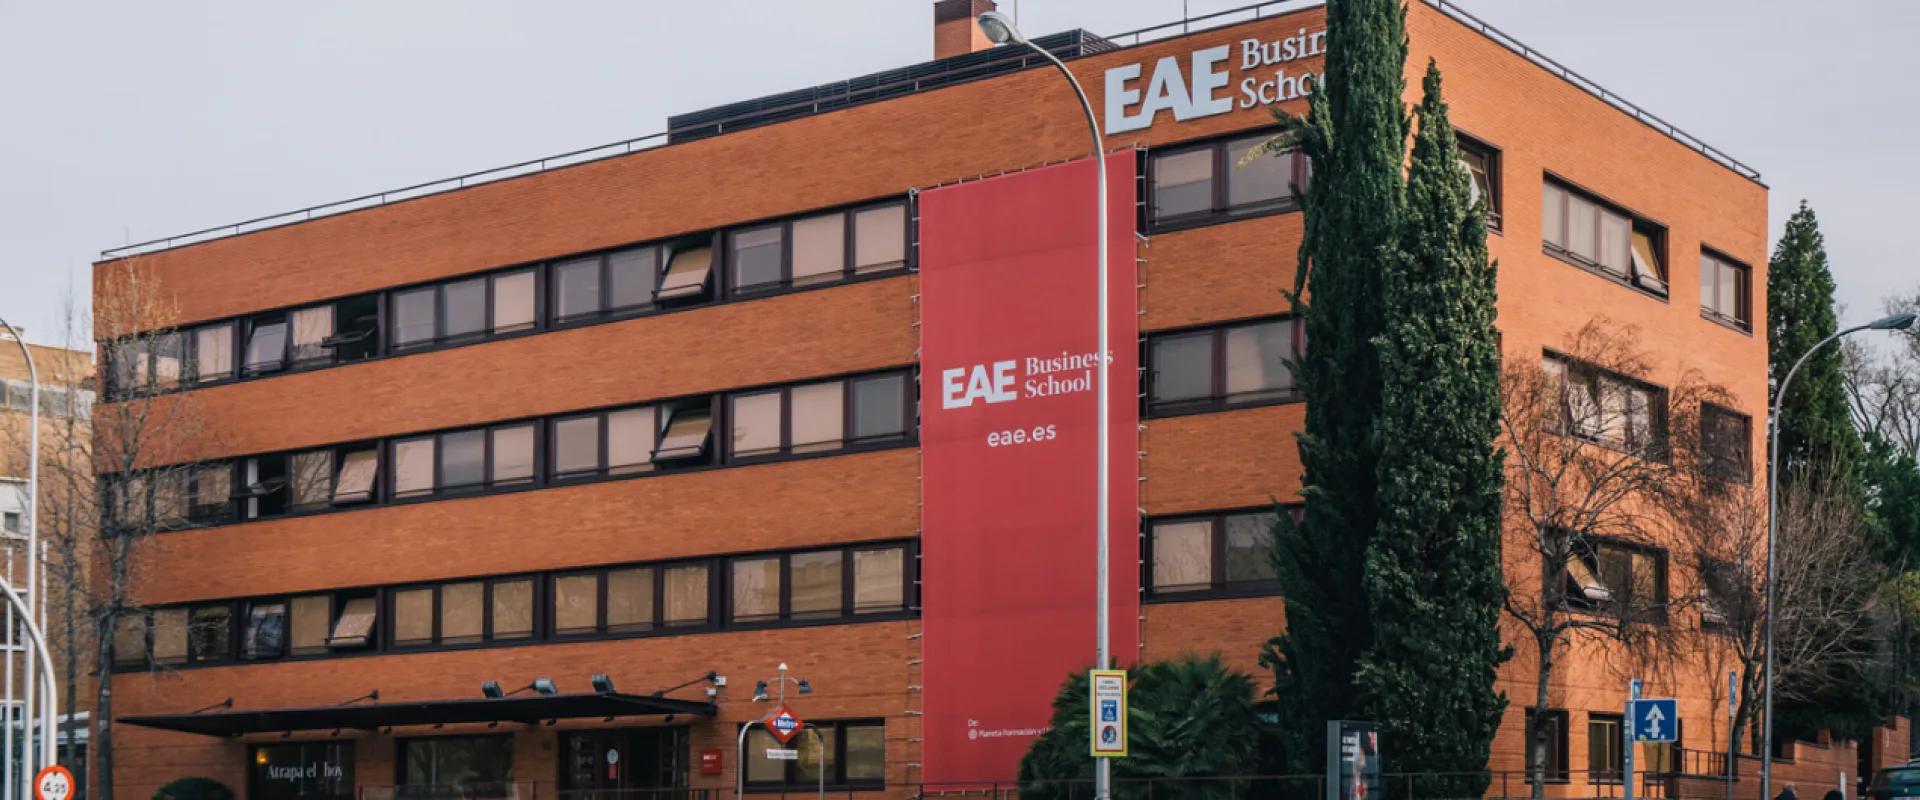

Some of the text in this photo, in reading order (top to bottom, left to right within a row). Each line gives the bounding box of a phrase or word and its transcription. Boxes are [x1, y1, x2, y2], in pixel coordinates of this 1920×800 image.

[1240, 28, 1326, 70] Busin
[1105, 44, 1233, 134] EAE
[1240, 70, 1326, 109] Scho
[942, 360, 1017, 409] EAE
[1025, 370, 1091, 399] School
[987, 424, 1056, 447] eae.es
[267, 764, 304, 782] Atrapa
[306, 761, 317, 778] el
